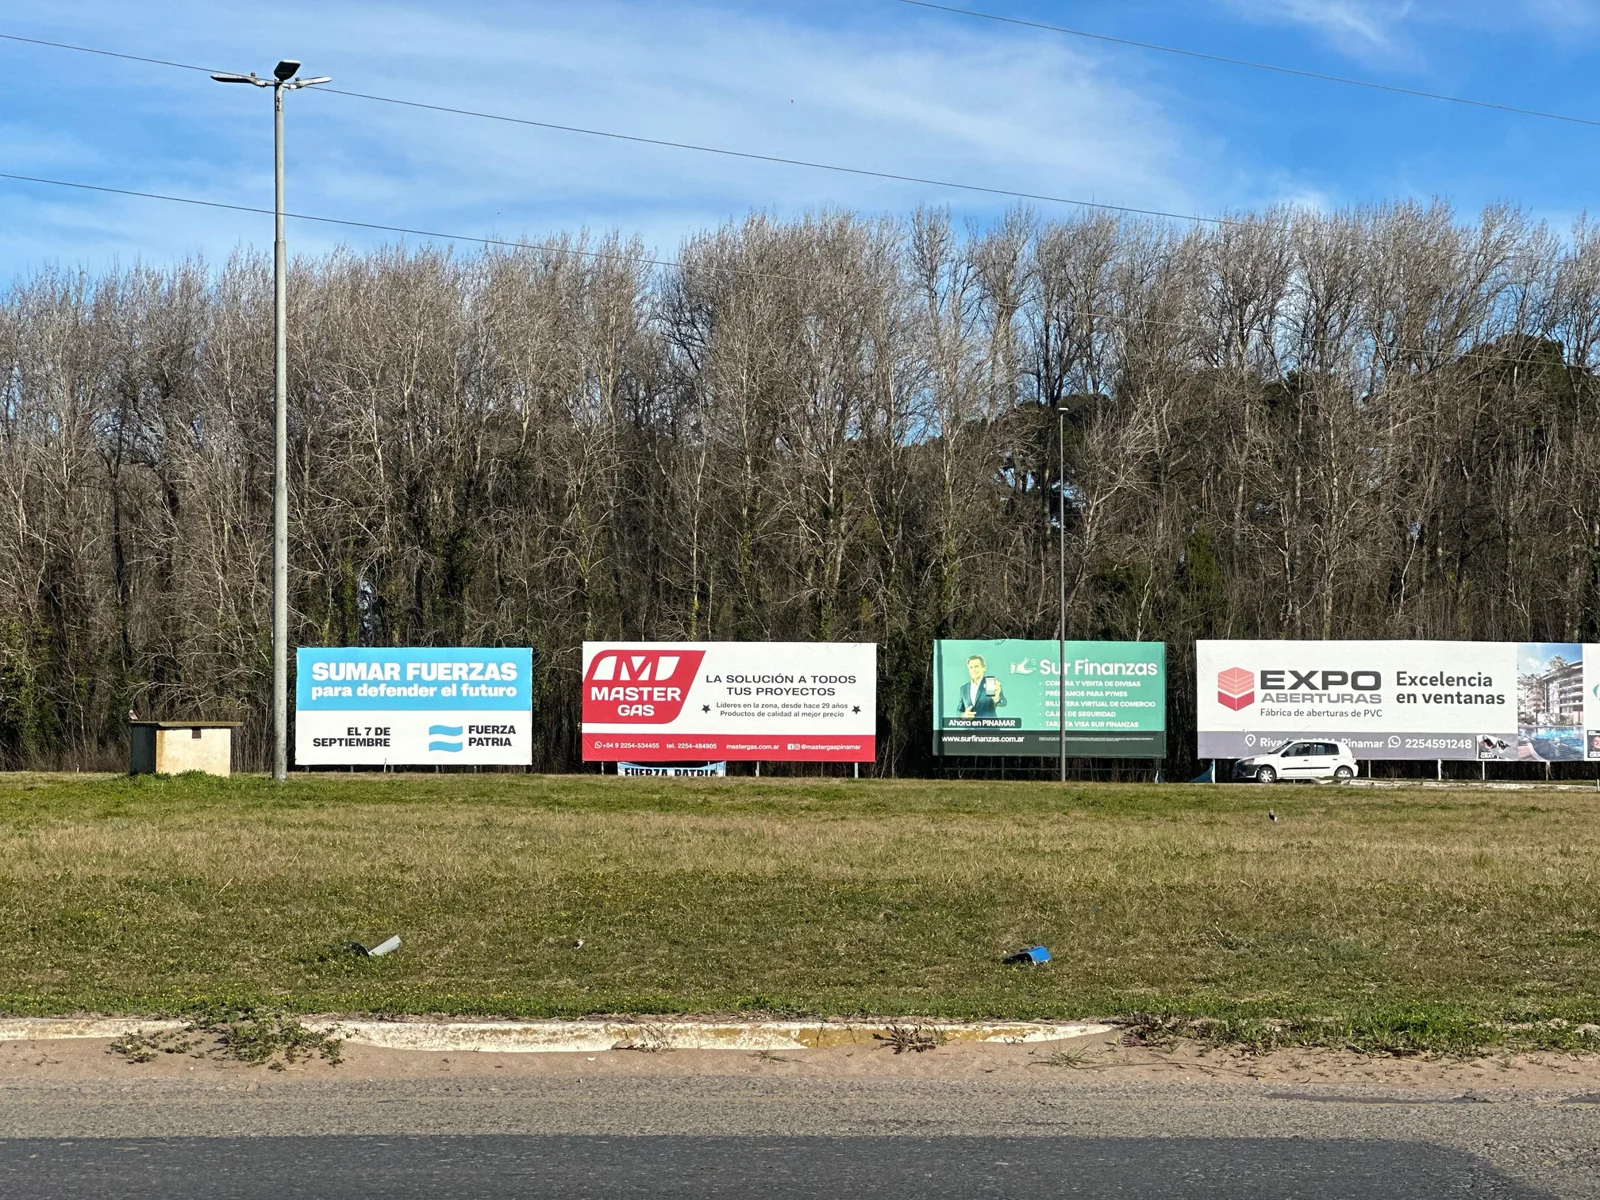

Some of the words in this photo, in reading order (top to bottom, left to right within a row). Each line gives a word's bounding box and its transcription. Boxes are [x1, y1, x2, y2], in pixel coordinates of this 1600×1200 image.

[312, 662, 400, 681] SUMAR
[406, 662, 518, 681] FUERZAS
[1040, 660, 1070, 675] Sur
[1075, 659, 1158, 676] Finanzas
[706, 675, 722, 683] LA
[726, 673, 794, 684] SOLUCIÓN
[798, 675, 807, 684] A
[811, 675, 856, 684] TODOS
[1260, 670, 1382, 690] EXPO
[1396, 671, 1492, 687] Excelencia
[312, 684, 352, 700] para
[356, 683, 437, 697] defender
[441, 683, 457, 697] el
[461, 683, 517, 697] futuro
[591, 687, 681, 701] MASTER
[726, 687, 752, 696] TUS
[756, 687, 836, 696] PROYECTOS
[1261, 693, 1382, 704] ABERTURAS
[1396, 693, 1417, 703] en
[1422, 691, 1505, 704] ventanas
[618, 705, 655, 716] GAS
[1260, 708, 1291, 716] Fábrica
[1306, 709, 1349, 717] aberturas
[347, 727, 362, 736] EL
[365, 727, 372, 736] 7
[375, 727, 391, 736] DE
[468, 725, 516, 734] FUERZA
[313, 738, 391, 747] SEPTIEMBRE
[468, 737, 512, 747] PATRIA
[1405, 739, 1472, 749] 2254591248
